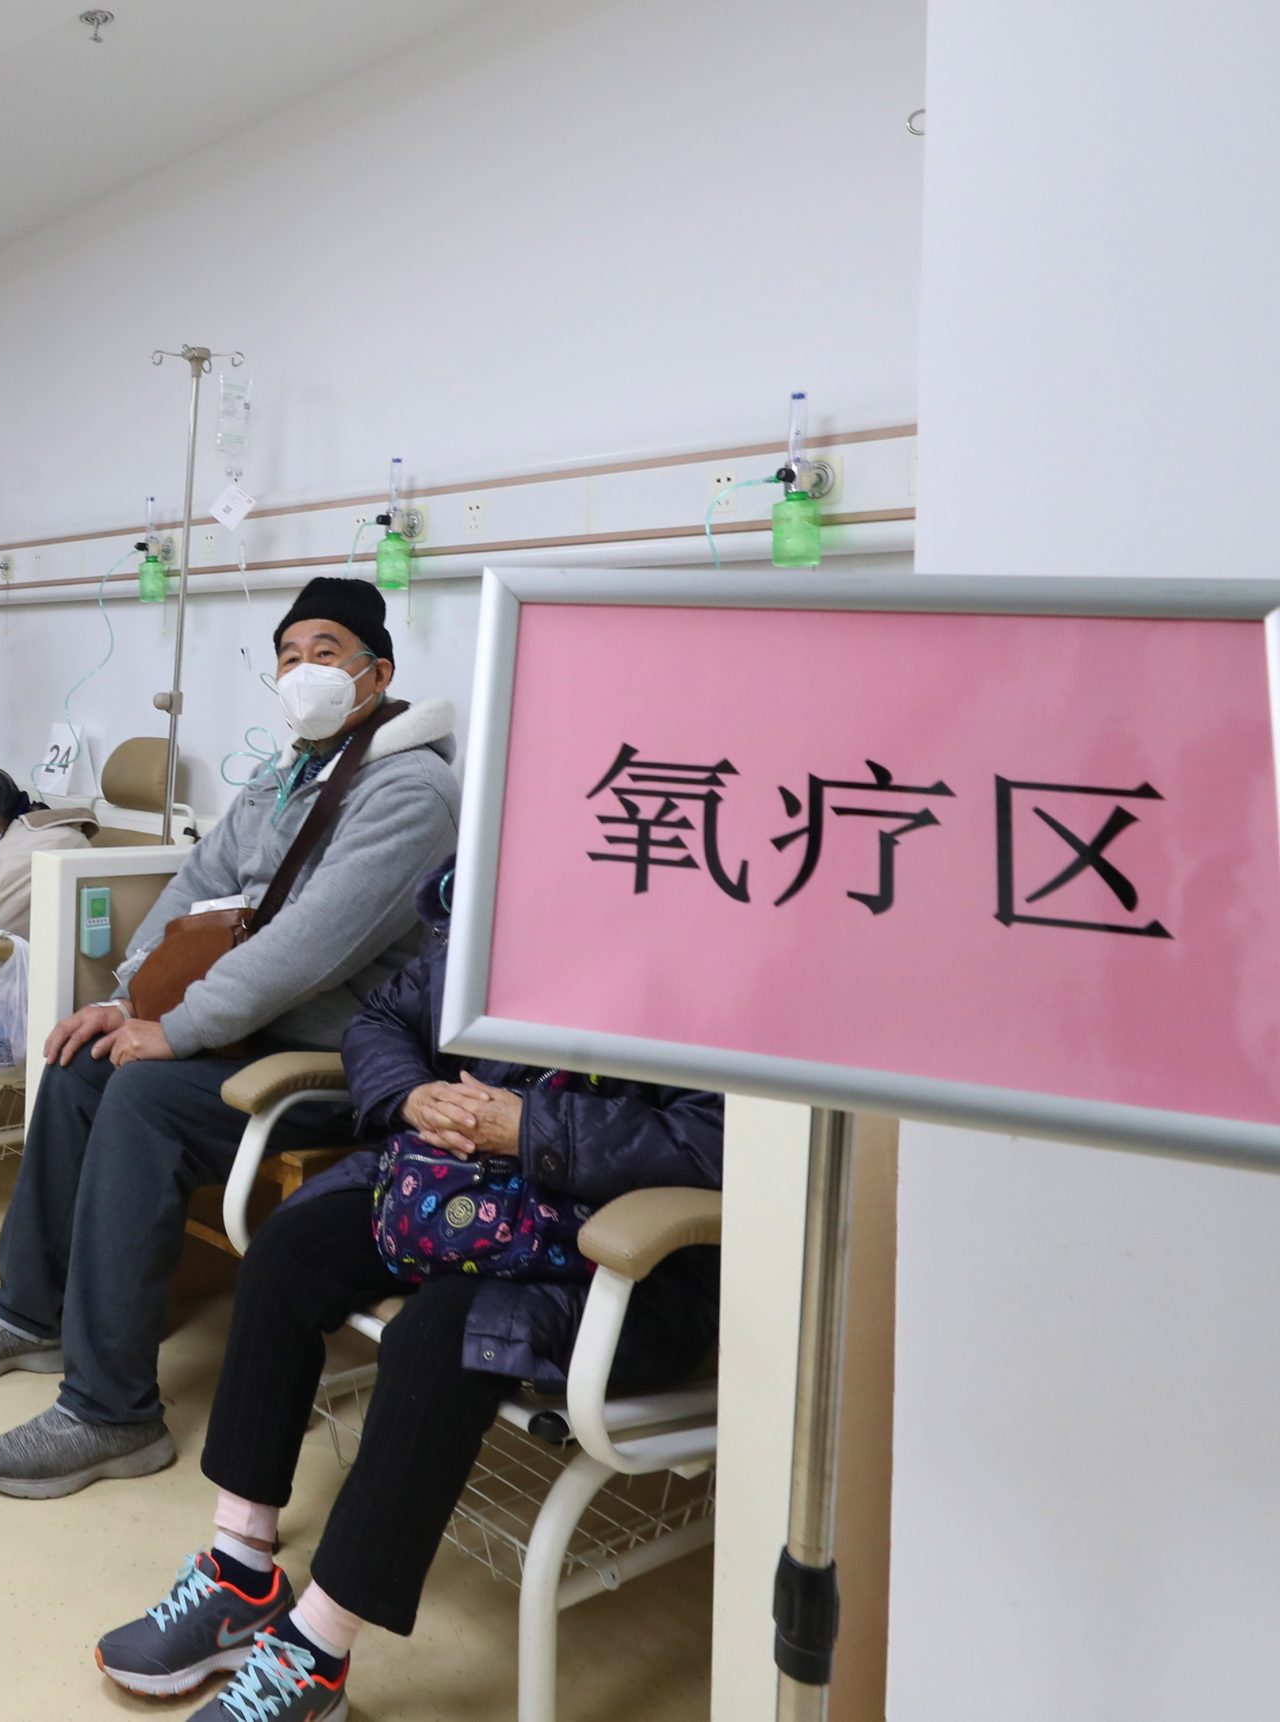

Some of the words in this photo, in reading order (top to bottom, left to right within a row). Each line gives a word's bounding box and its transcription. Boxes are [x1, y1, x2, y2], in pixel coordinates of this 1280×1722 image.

[44, 744, 72, 775] 24
[585, 742, 1175, 940] 氧疗区
